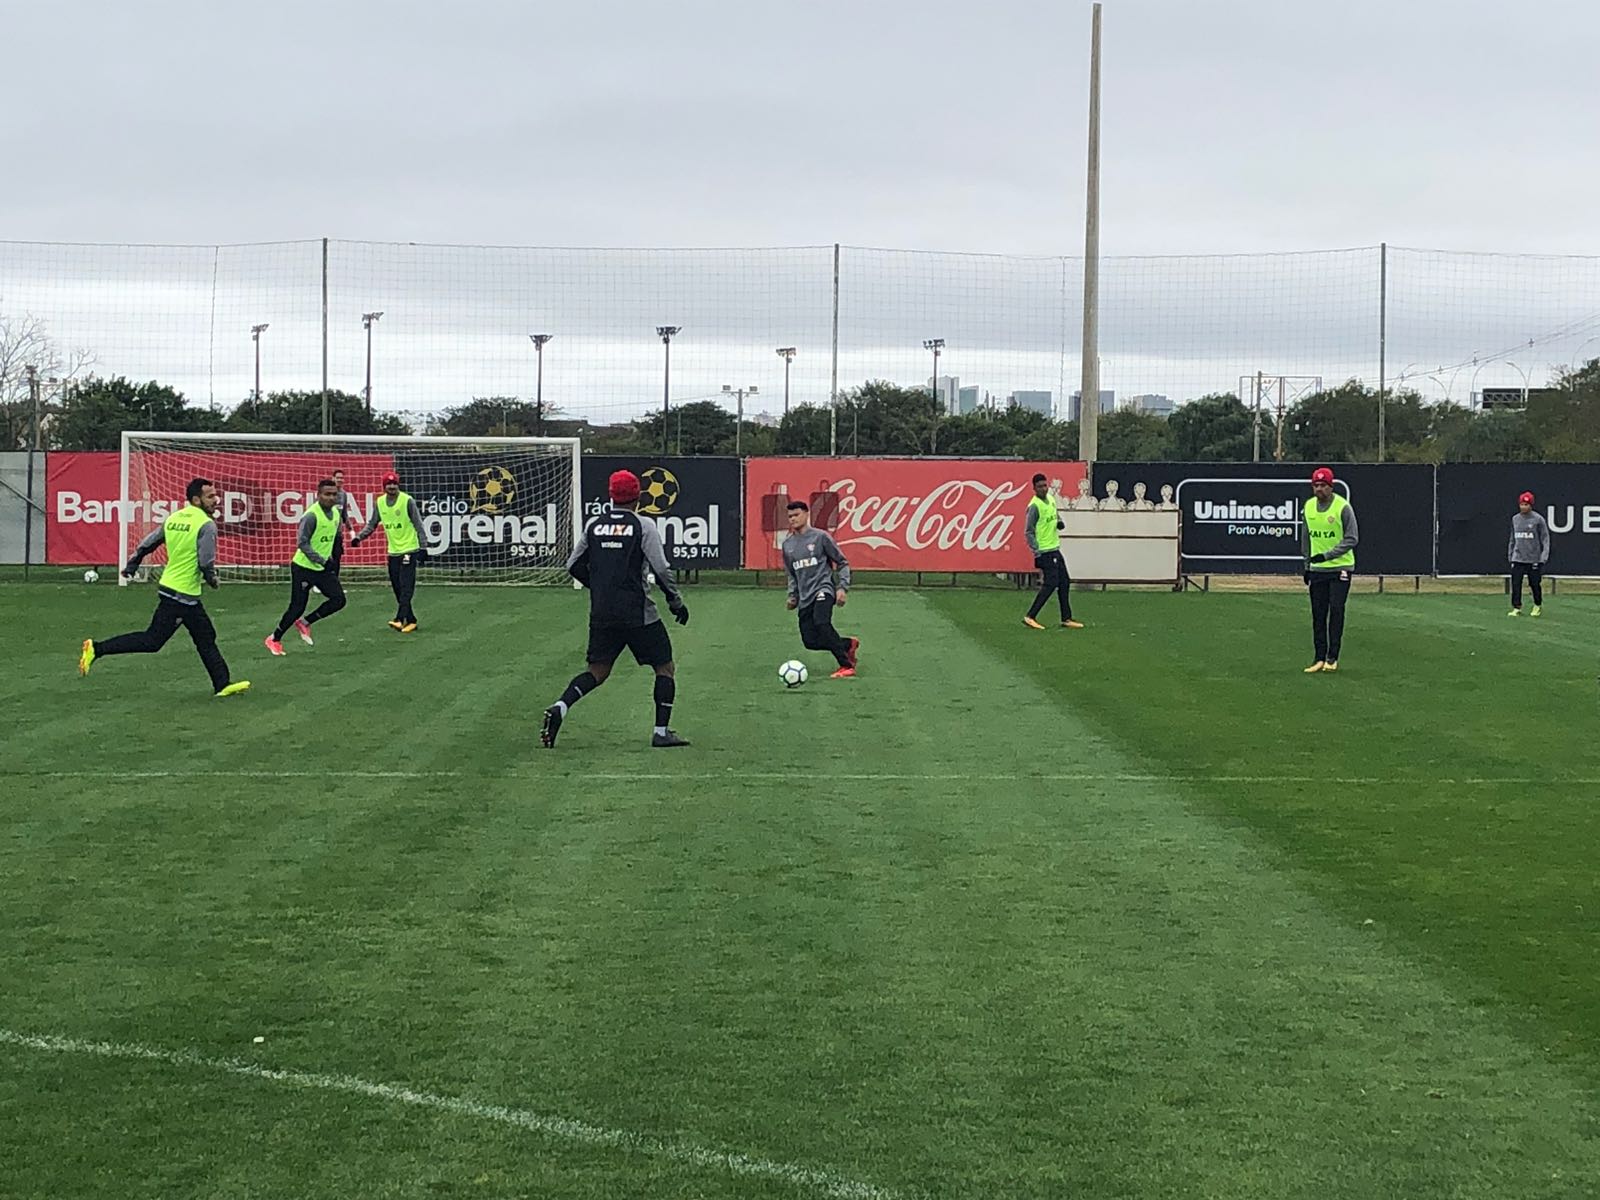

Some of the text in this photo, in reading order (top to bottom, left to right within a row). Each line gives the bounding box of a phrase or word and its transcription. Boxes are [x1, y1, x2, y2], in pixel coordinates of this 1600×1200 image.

[57, 490, 190, 524] Banris
[421, 495, 468, 514] rádio
[585, 496, 614, 515] rád
[1194, 500, 1294, 520] Unimed
[826, 478, 1029, 551] Coca-Cola
[423, 503, 557, 555] grenal
[593, 524, 634, 536] CAIXA
[1228, 524, 1293, 538] Porto Alegre
[511, 545, 557, 557] 95,9 FM
[673, 546, 719, 560] 95,9 FM
